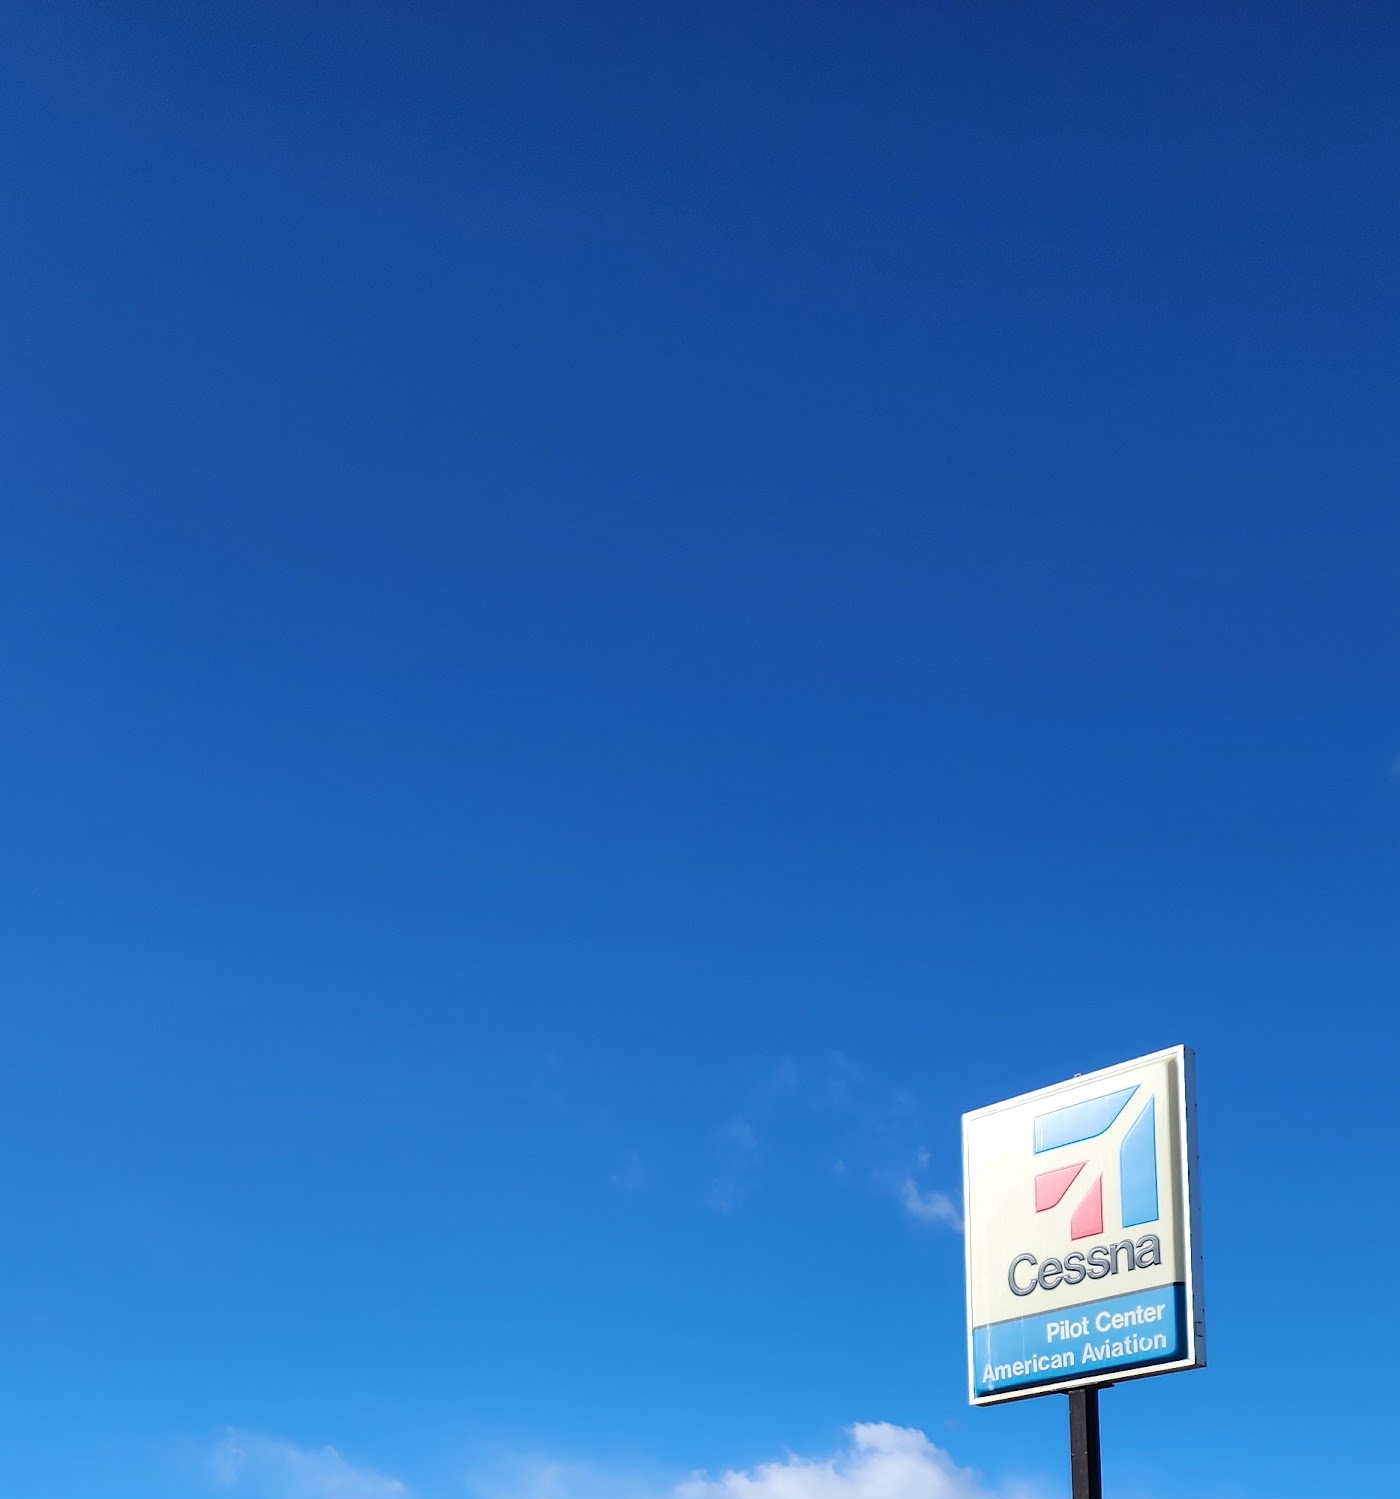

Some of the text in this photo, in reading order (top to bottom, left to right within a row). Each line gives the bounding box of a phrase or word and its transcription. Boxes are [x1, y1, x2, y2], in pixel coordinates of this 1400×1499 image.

[1007, 1233, 1161, 1297] Cessna
[1046, 1304, 1166, 1343] Pilot Center
[982, 1333, 1167, 1383] American Aviation
